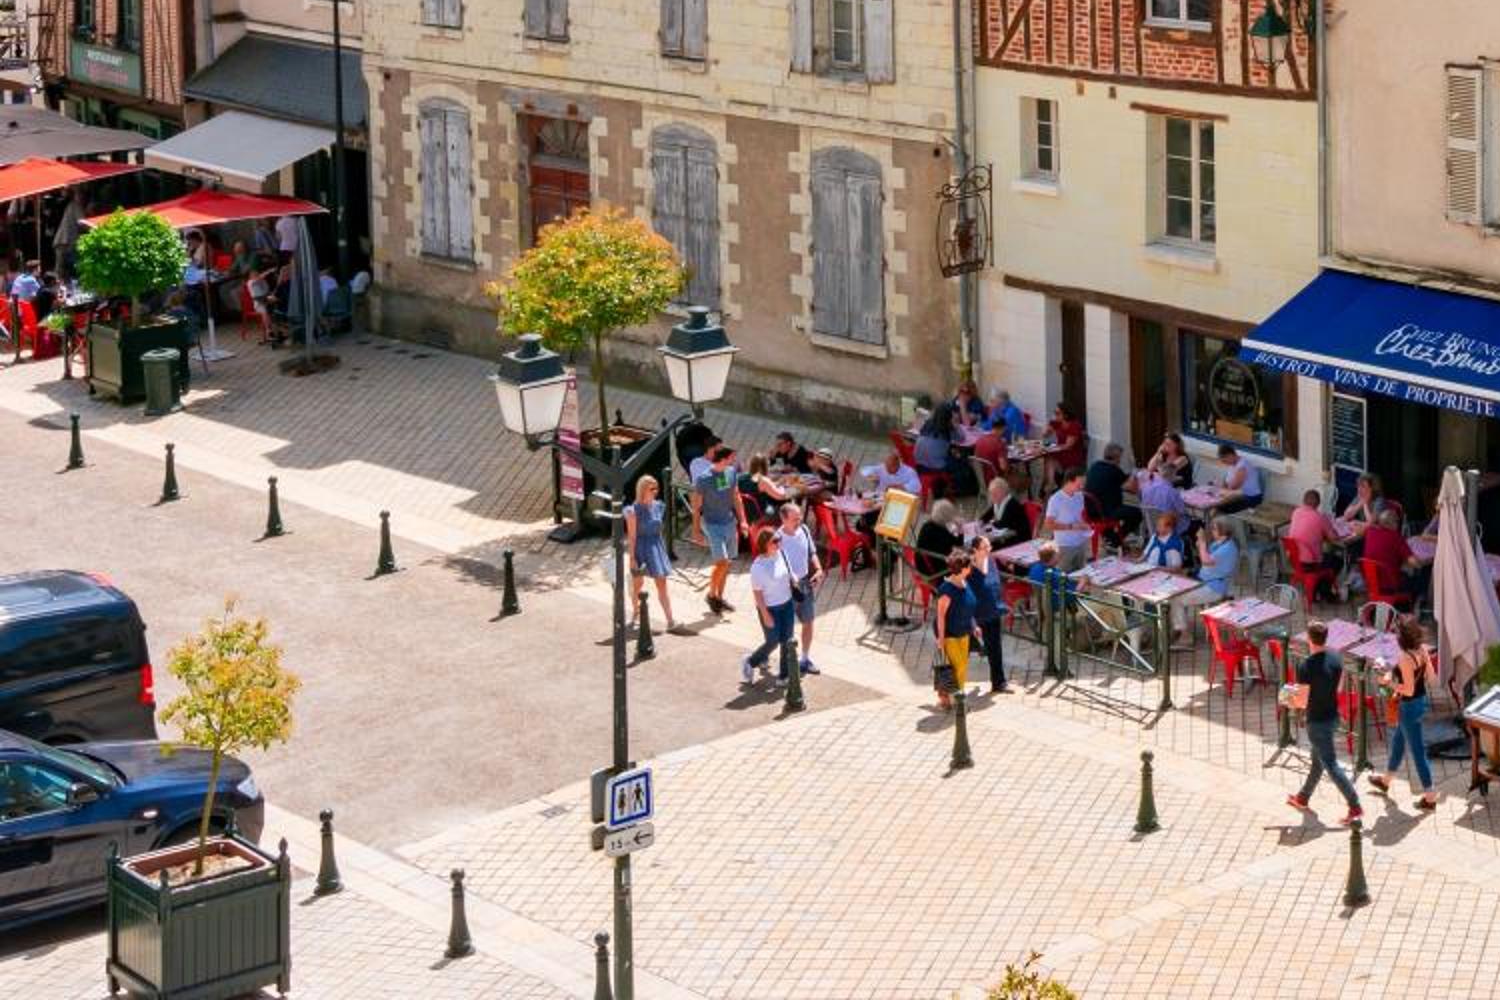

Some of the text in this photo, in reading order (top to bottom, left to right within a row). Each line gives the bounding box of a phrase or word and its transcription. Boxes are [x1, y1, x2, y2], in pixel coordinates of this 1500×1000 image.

[1375, 328, 1436, 363] Chez
[1253, 352, 1322, 377] BISTROT
[1333, 369, 1371, 388] VINS
[1374, 379, 1399, 396] DE
[1405, 386, 1495, 417] PROPRIETE
